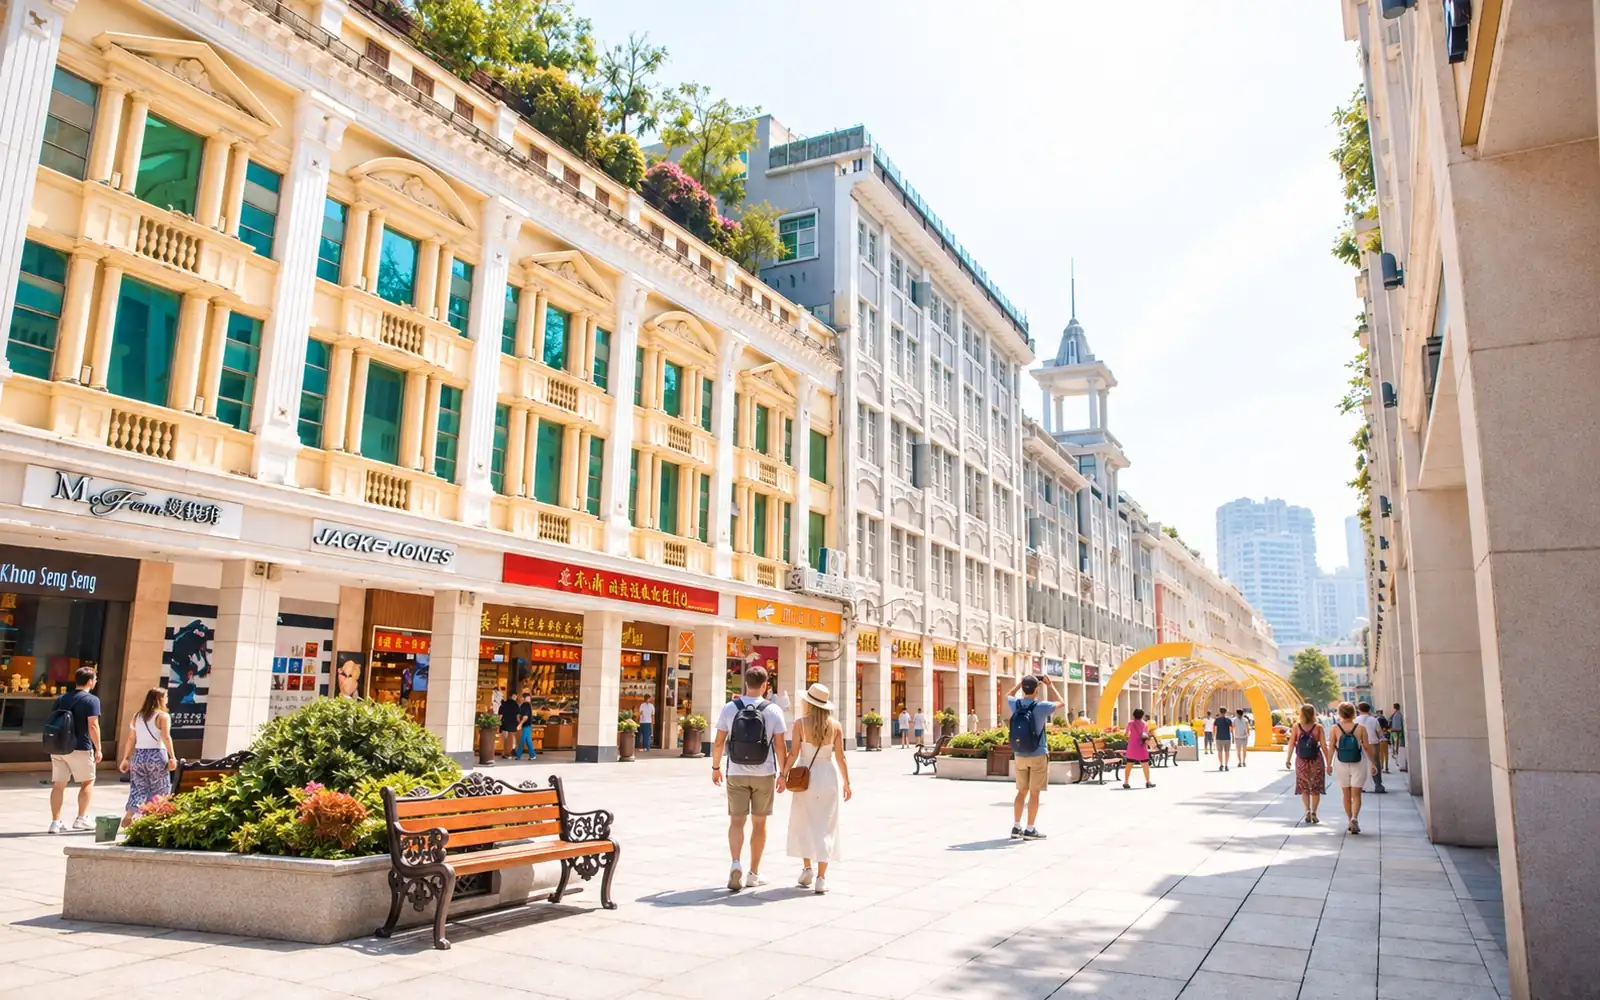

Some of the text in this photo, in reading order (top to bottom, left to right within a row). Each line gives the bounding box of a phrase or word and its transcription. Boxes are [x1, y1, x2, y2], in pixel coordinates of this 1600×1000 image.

[0, 564, 97, 594] Khoo Seng Seng
